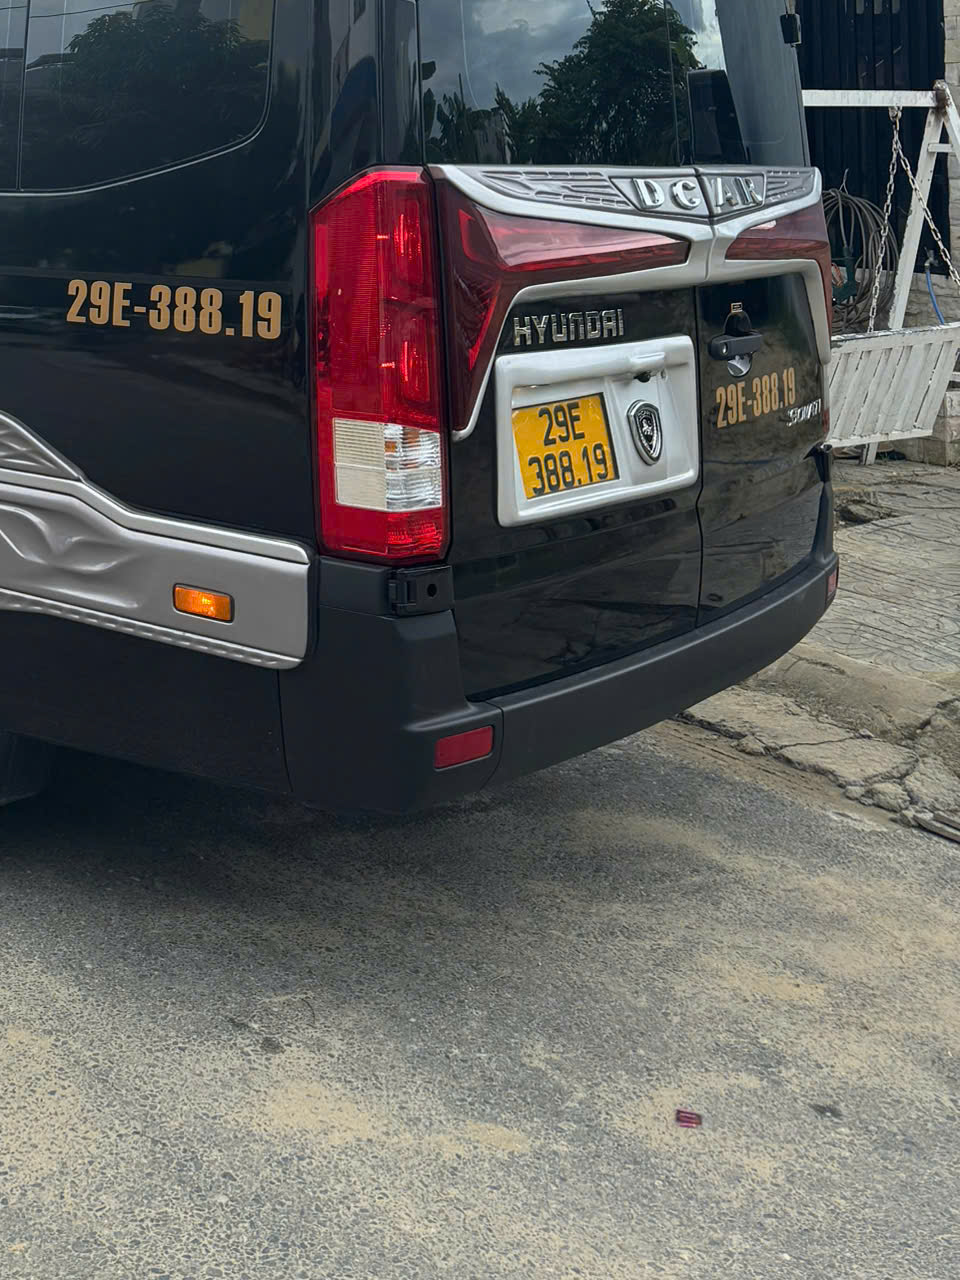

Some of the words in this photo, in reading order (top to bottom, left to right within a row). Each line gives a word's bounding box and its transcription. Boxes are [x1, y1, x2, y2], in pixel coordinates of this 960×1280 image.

[66, 279, 282, 340] 29E-388.19
[513, 308, 624, 346] HYUNDAI
[538, 402, 585, 447] 29E
[715, 367, 796, 428] 29E-388.19
[528, 442, 609, 497] 388.19
